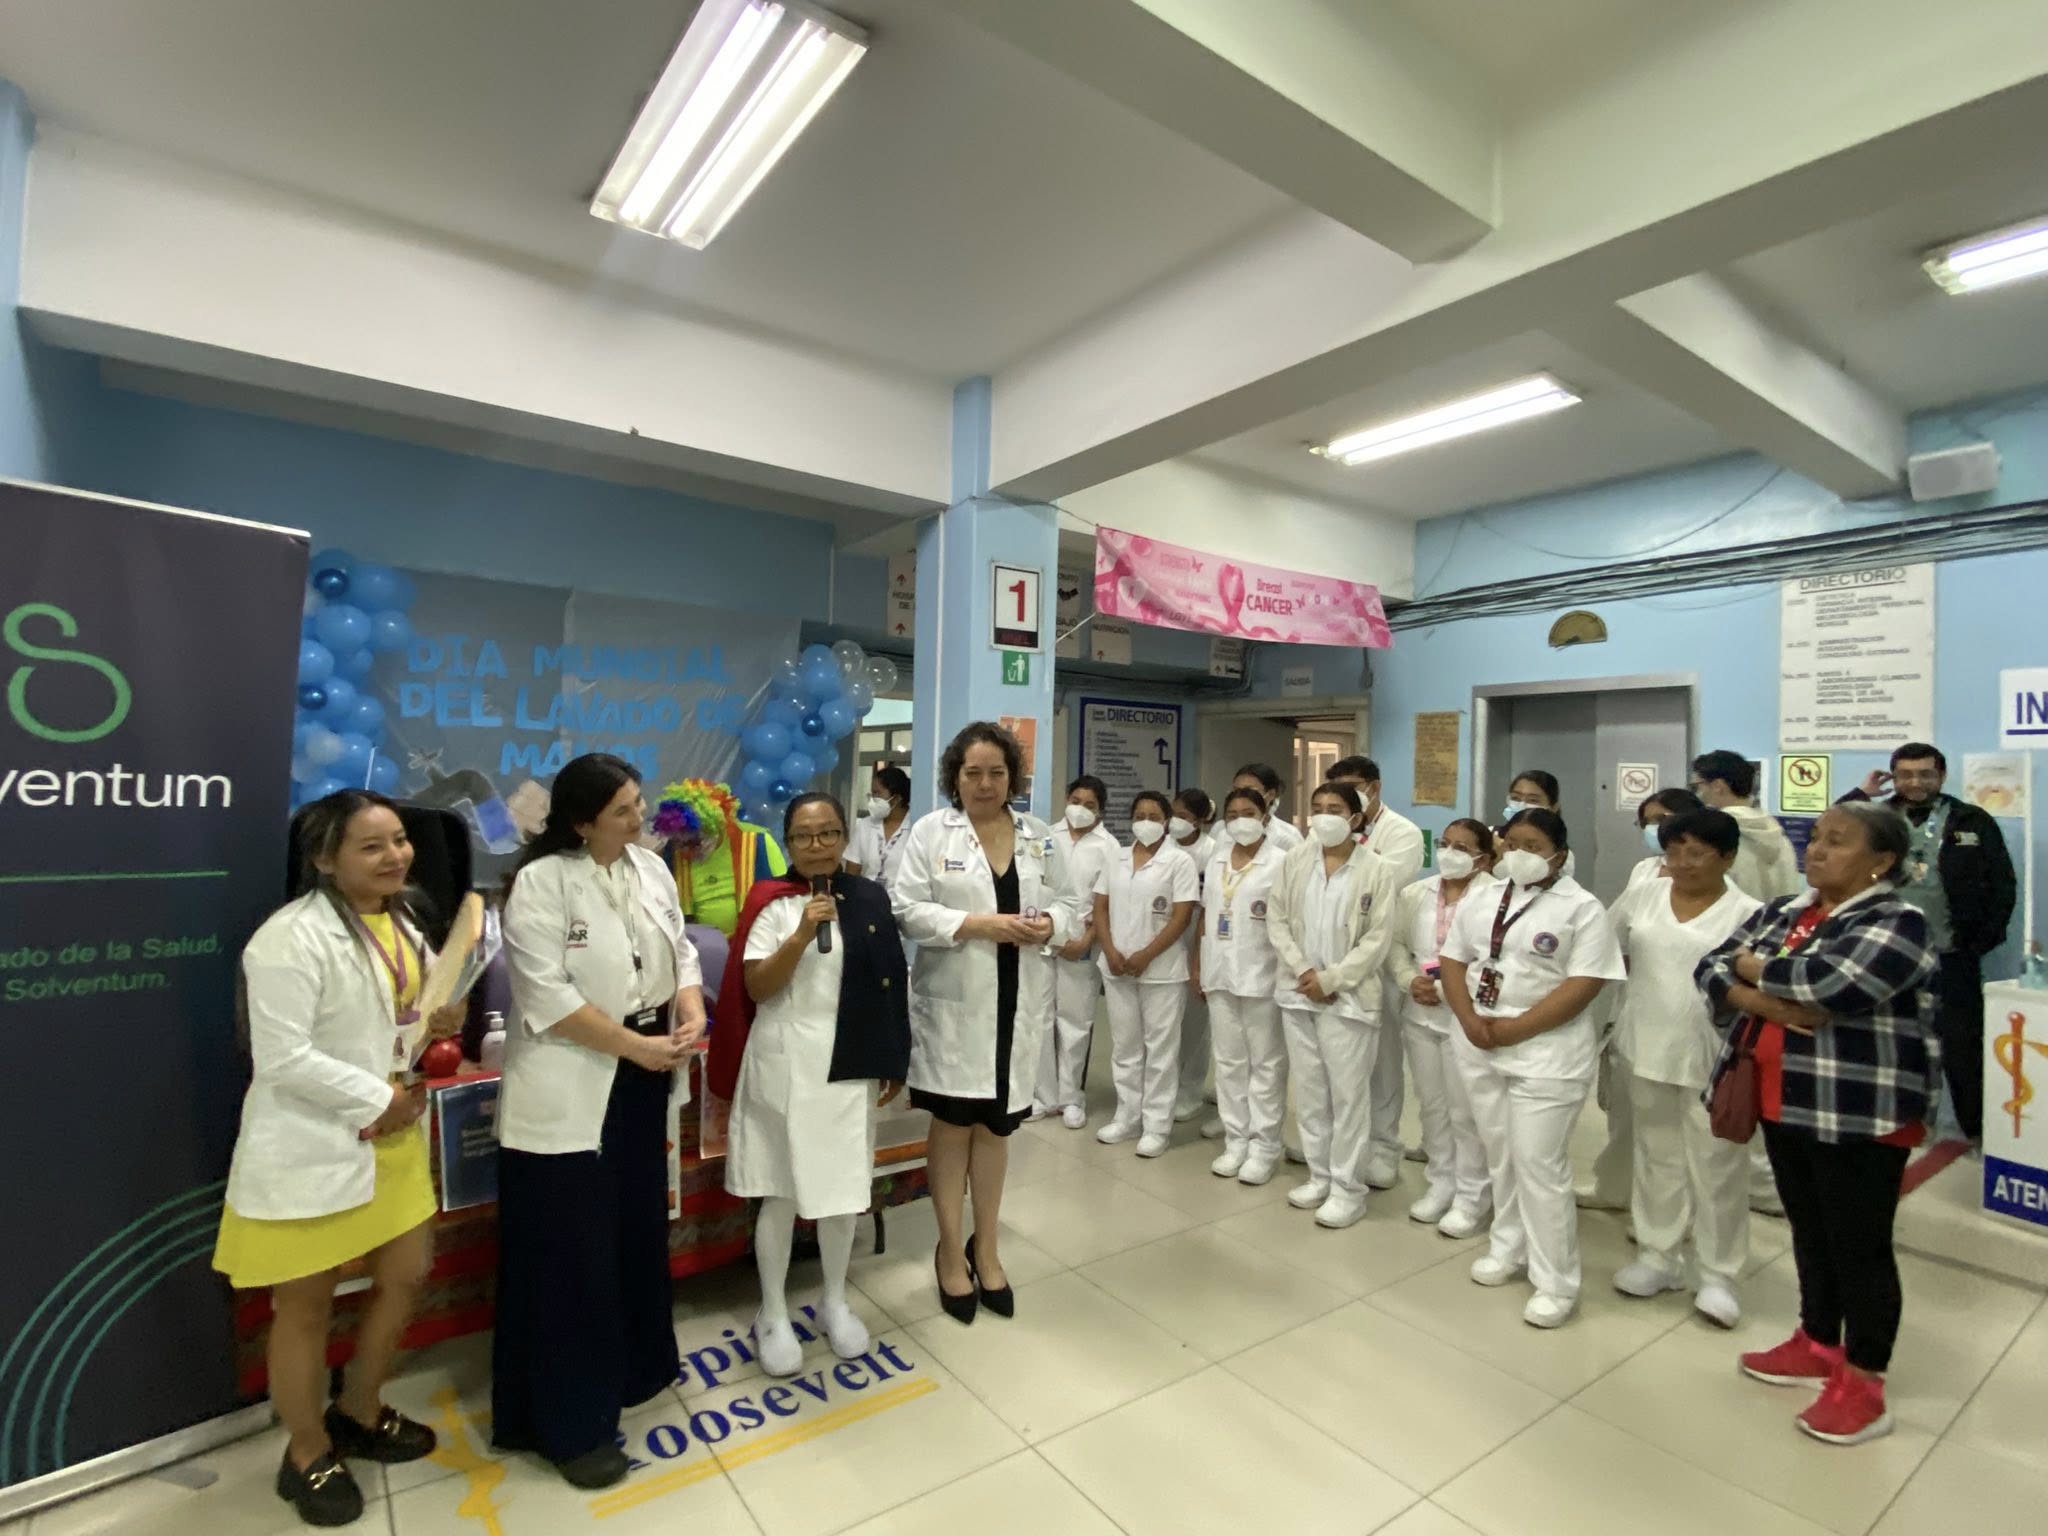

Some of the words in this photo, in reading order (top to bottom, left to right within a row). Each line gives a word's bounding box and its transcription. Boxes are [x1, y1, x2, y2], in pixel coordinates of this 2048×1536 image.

[1800, 567, 1906, 590] DIRECTORIO
[1009, 580, 1025, 622] 1
[1246, 594, 1293, 616] CANCER
[534, 643, 736, 685] MUNDIAL
[400, 680, 502, 728] DEL
[515, 687, 680, 736] LAVADO
[1107, 708, 1174, 725] DIRECTORIO
[2016, 691, 2048, 725] IN
[58, 942, 98, 965] de
[107, 940, 131, 961] la
[614, 1341, 915, 1470] oosevelt
